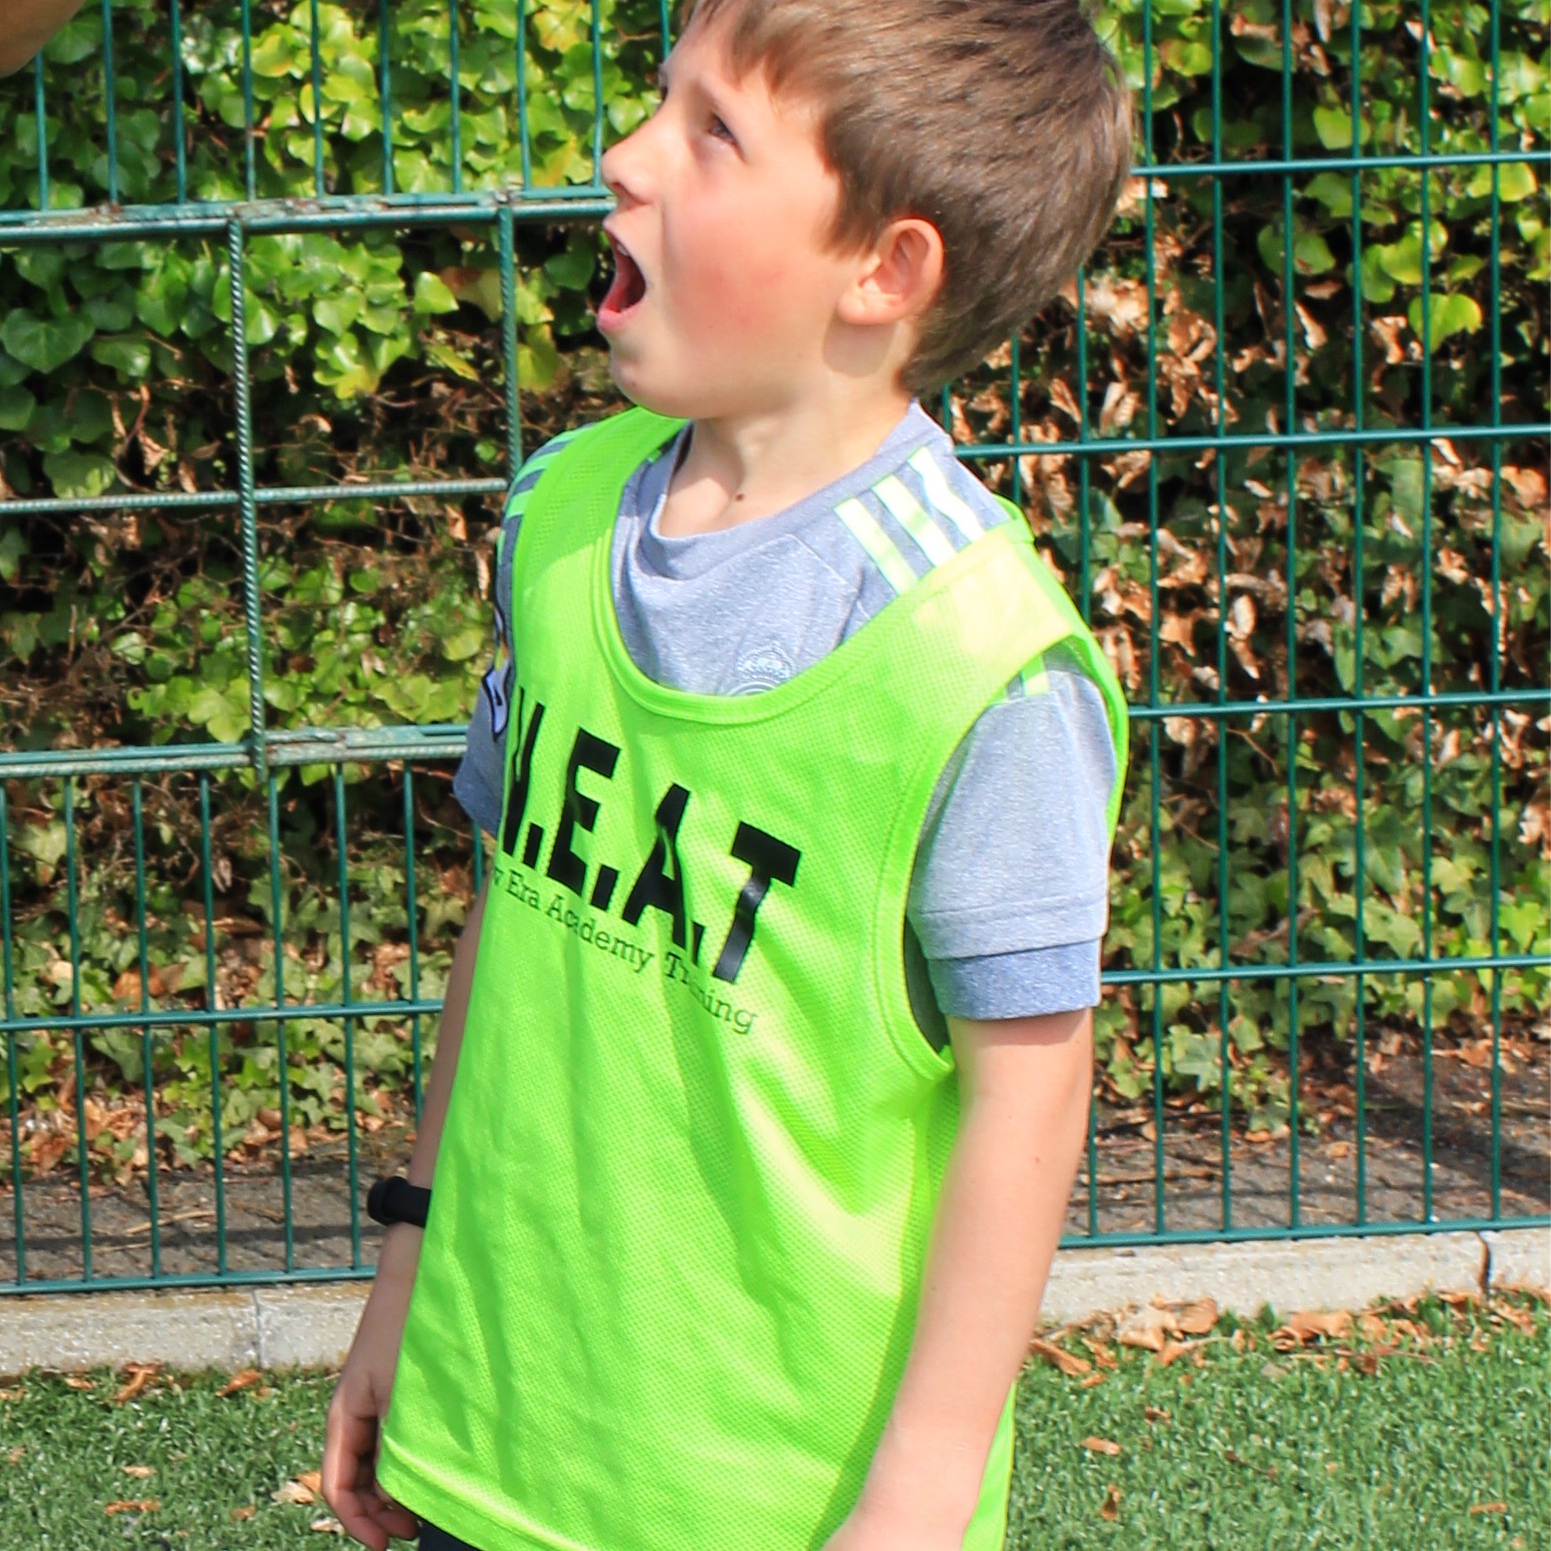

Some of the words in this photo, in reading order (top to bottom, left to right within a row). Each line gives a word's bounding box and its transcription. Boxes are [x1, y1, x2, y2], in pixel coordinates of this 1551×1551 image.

[506, 869, 541, 910] Era
[546, 894, 655, 974] Academy
[665, 950, 758, 1036] Tring
